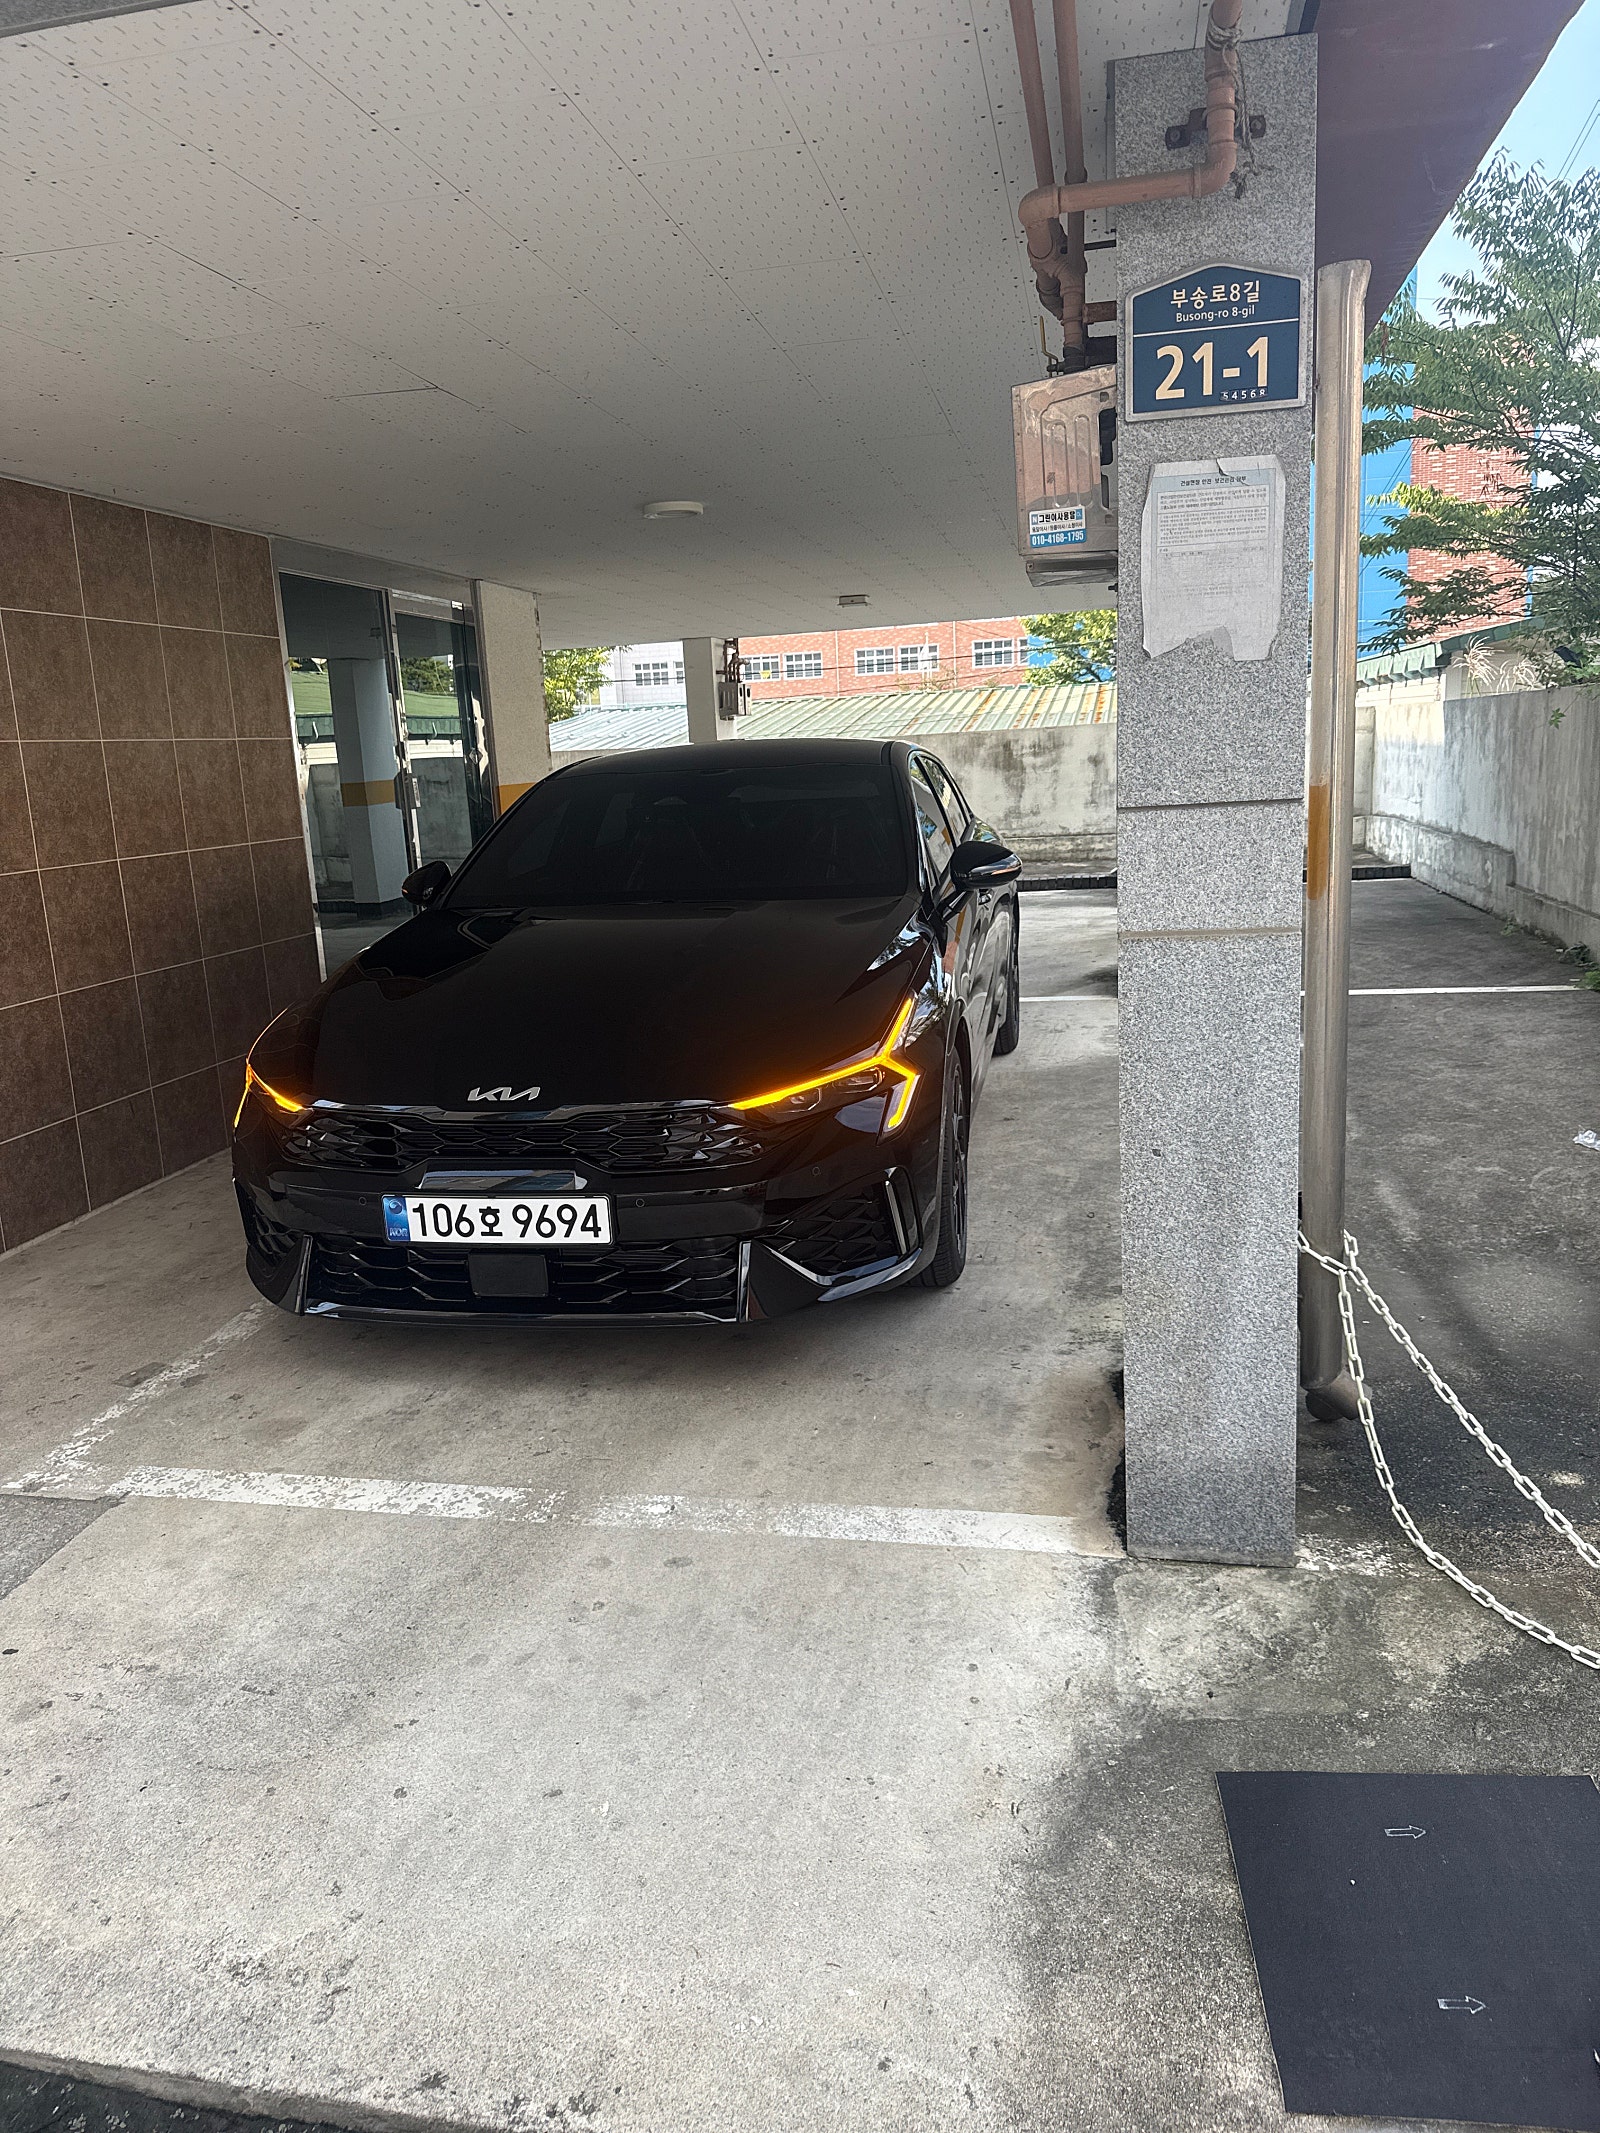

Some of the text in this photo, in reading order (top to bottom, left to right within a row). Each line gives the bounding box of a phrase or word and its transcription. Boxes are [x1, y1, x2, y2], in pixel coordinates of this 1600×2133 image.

[1170, 280, 1260, 310] 부송로8길
[1176, 304, 1255, 322] Busong-ro 8-gil
[1155, 336, 1268, 400] 21-1
[1031, 530, 1084, 546] 010-4168-1795
[467, 1086, 541, 1102] KIA
[412, 1202, 602, 1239] 106호 9694
